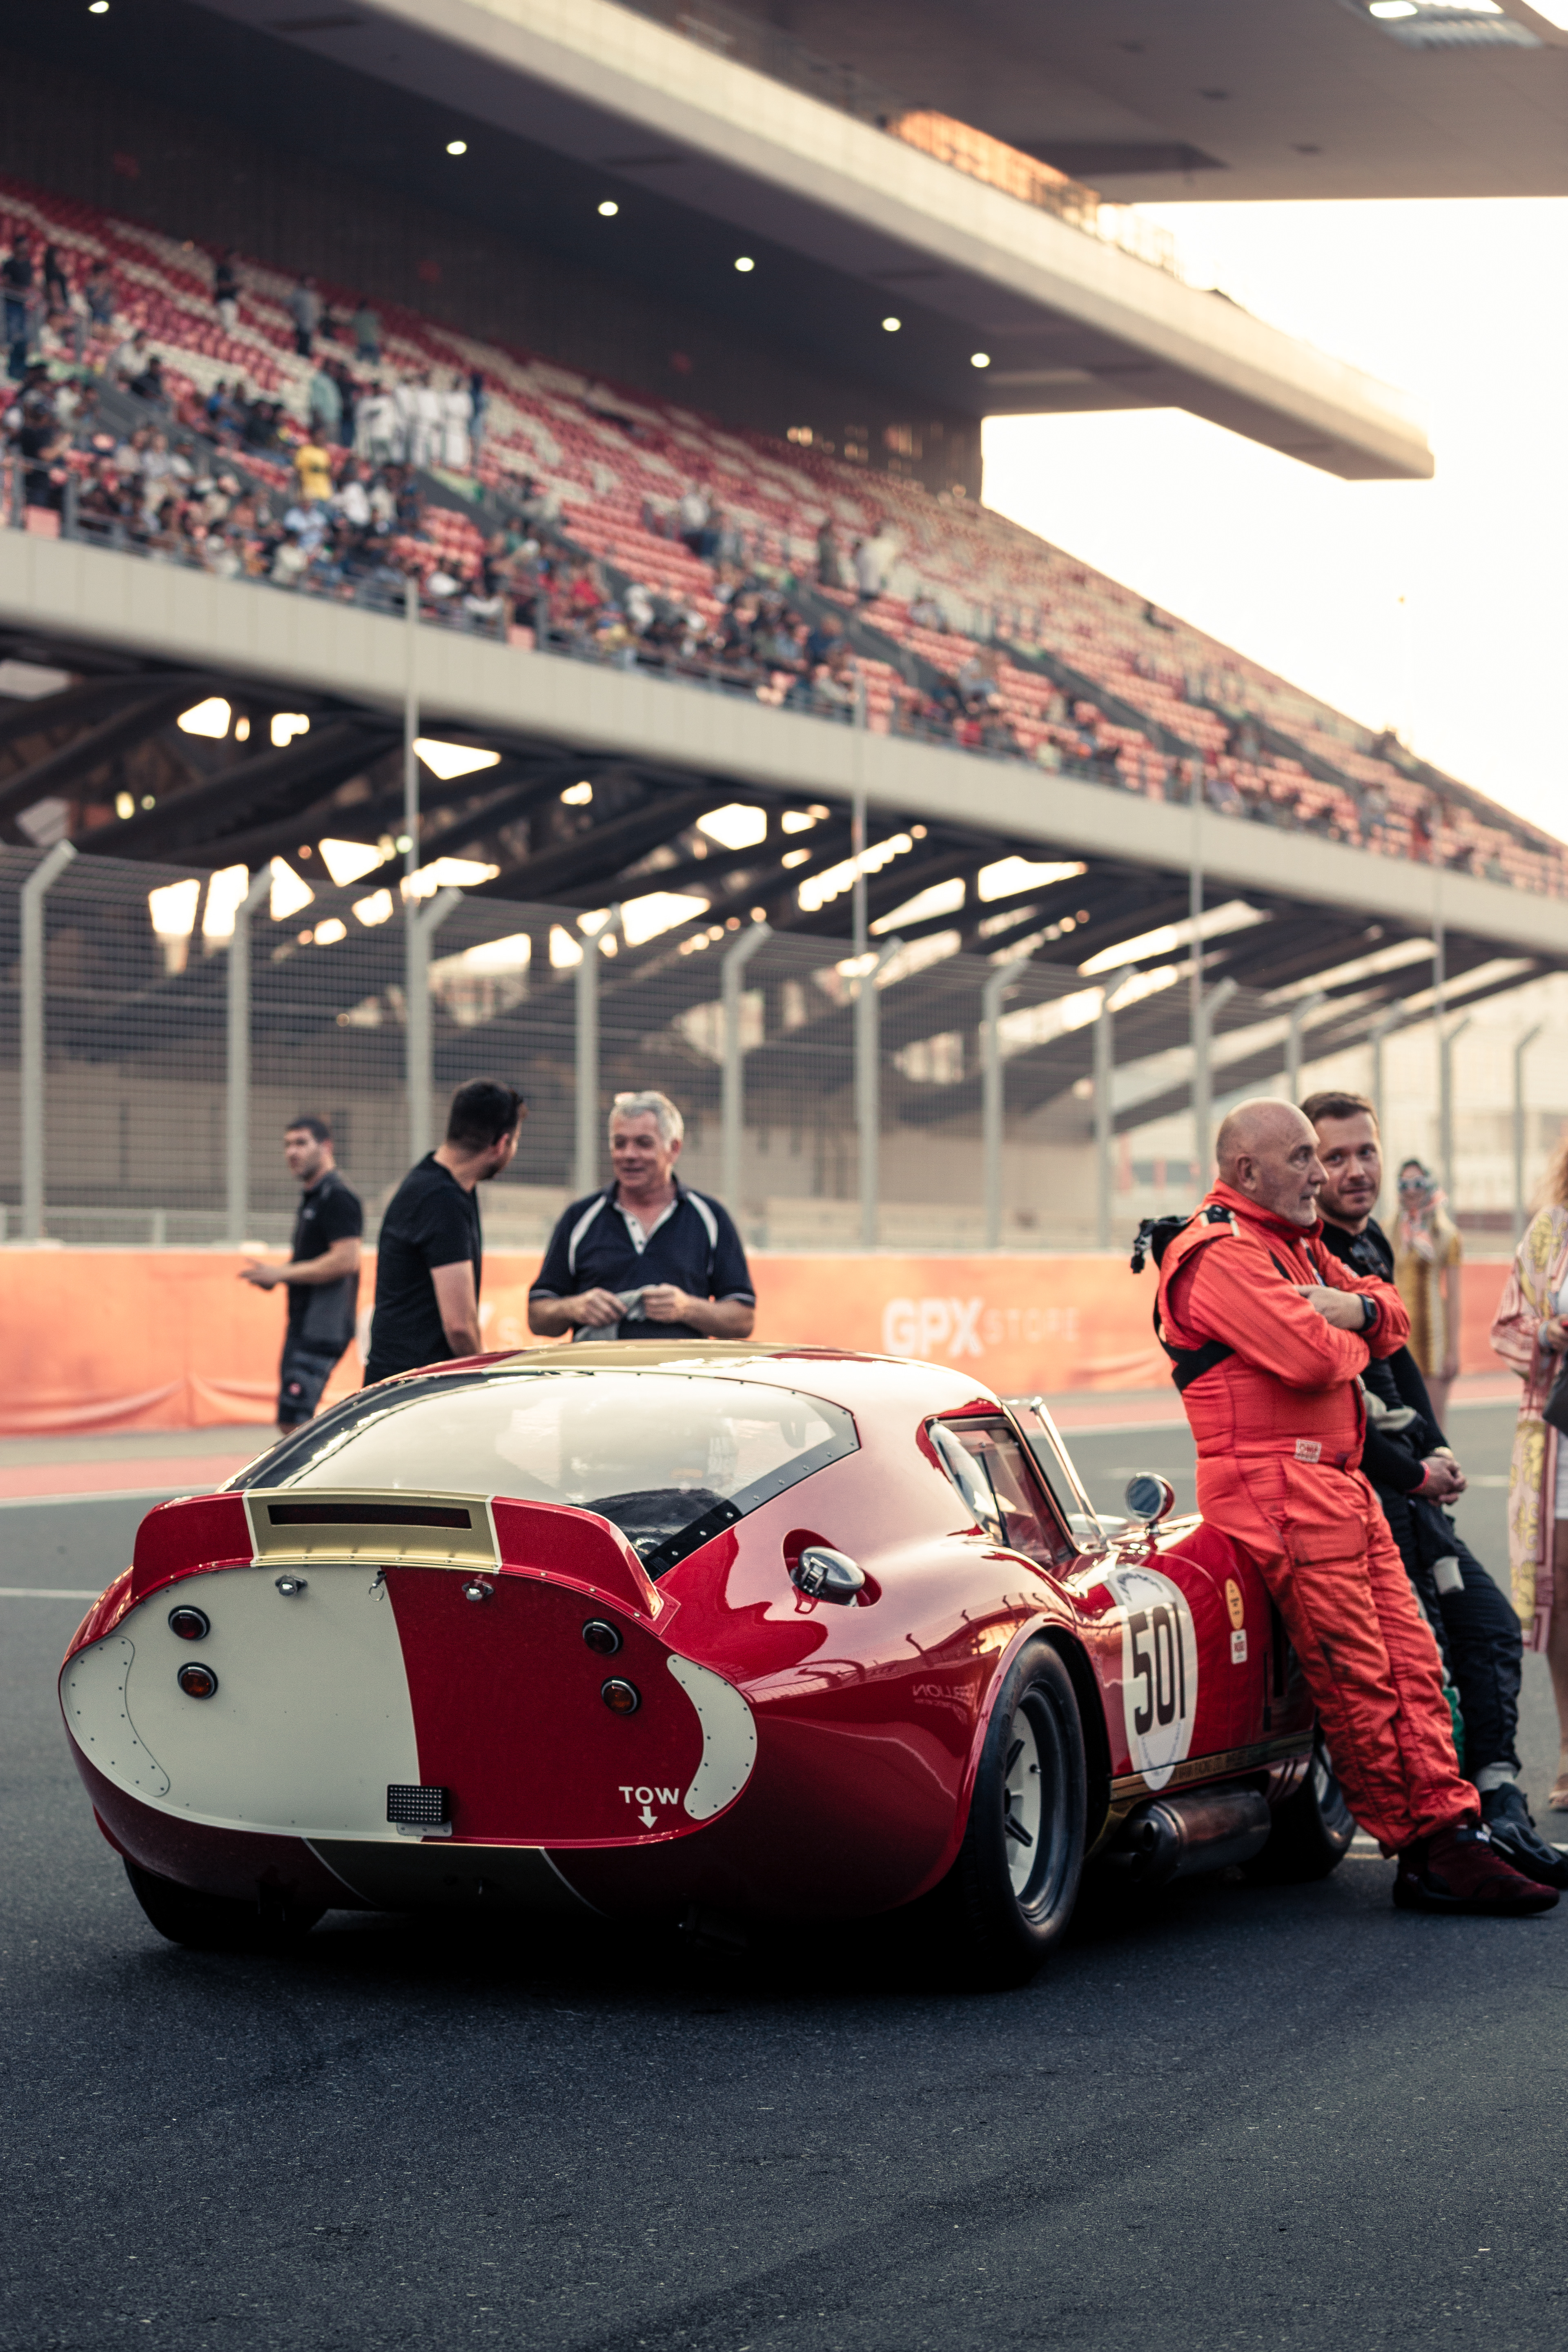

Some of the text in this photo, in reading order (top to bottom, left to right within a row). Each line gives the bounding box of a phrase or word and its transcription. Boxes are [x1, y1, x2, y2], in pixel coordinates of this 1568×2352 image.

[882, 1296, 984, 1359] GPX
[1128, 1603, 1185, 1735] 501
[619, 1786, 679, 1804] TOW
